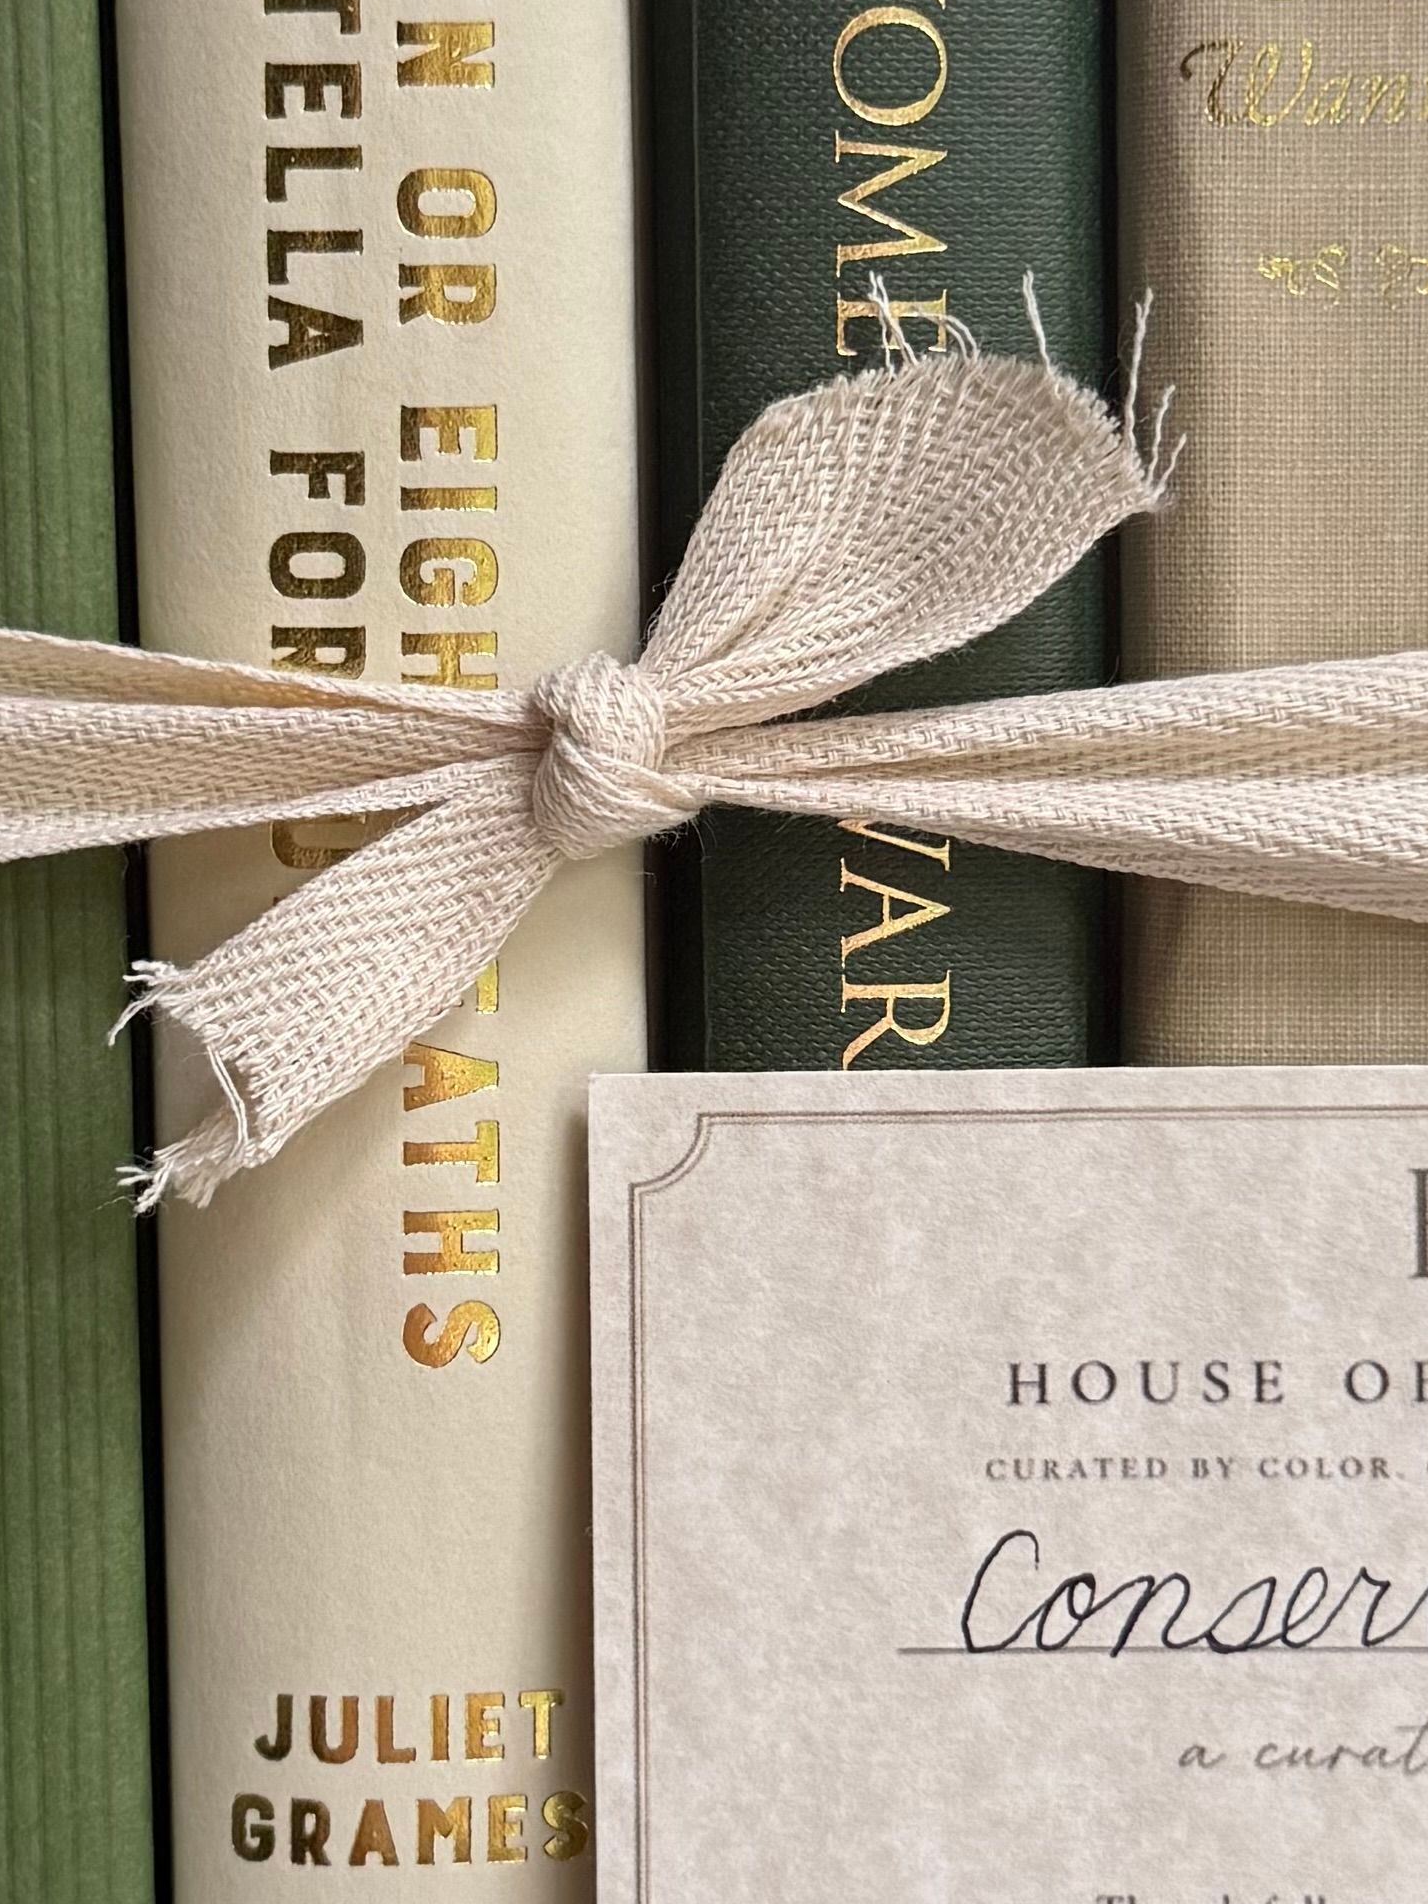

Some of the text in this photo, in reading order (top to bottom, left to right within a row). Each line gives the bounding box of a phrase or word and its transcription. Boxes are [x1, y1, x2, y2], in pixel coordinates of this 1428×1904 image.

[396, 166, 499, 327] OR
[399, 403, 499, 692] EIGH
[400, 959, 502, 1370] ATHS
[1005, 1358, 1286, 1409] HOUSE
[984, 1455, 1170, 1483] CURATED
[1190, 1455, 1236, 1482] BY
[1256, 1455, 1406, 1481] COLOR.
[254, 1690, 565, 1765] JULIET
[1177, 1742, 1226, 1771] a
[231, 1791, 590, 1867] GRAMES
